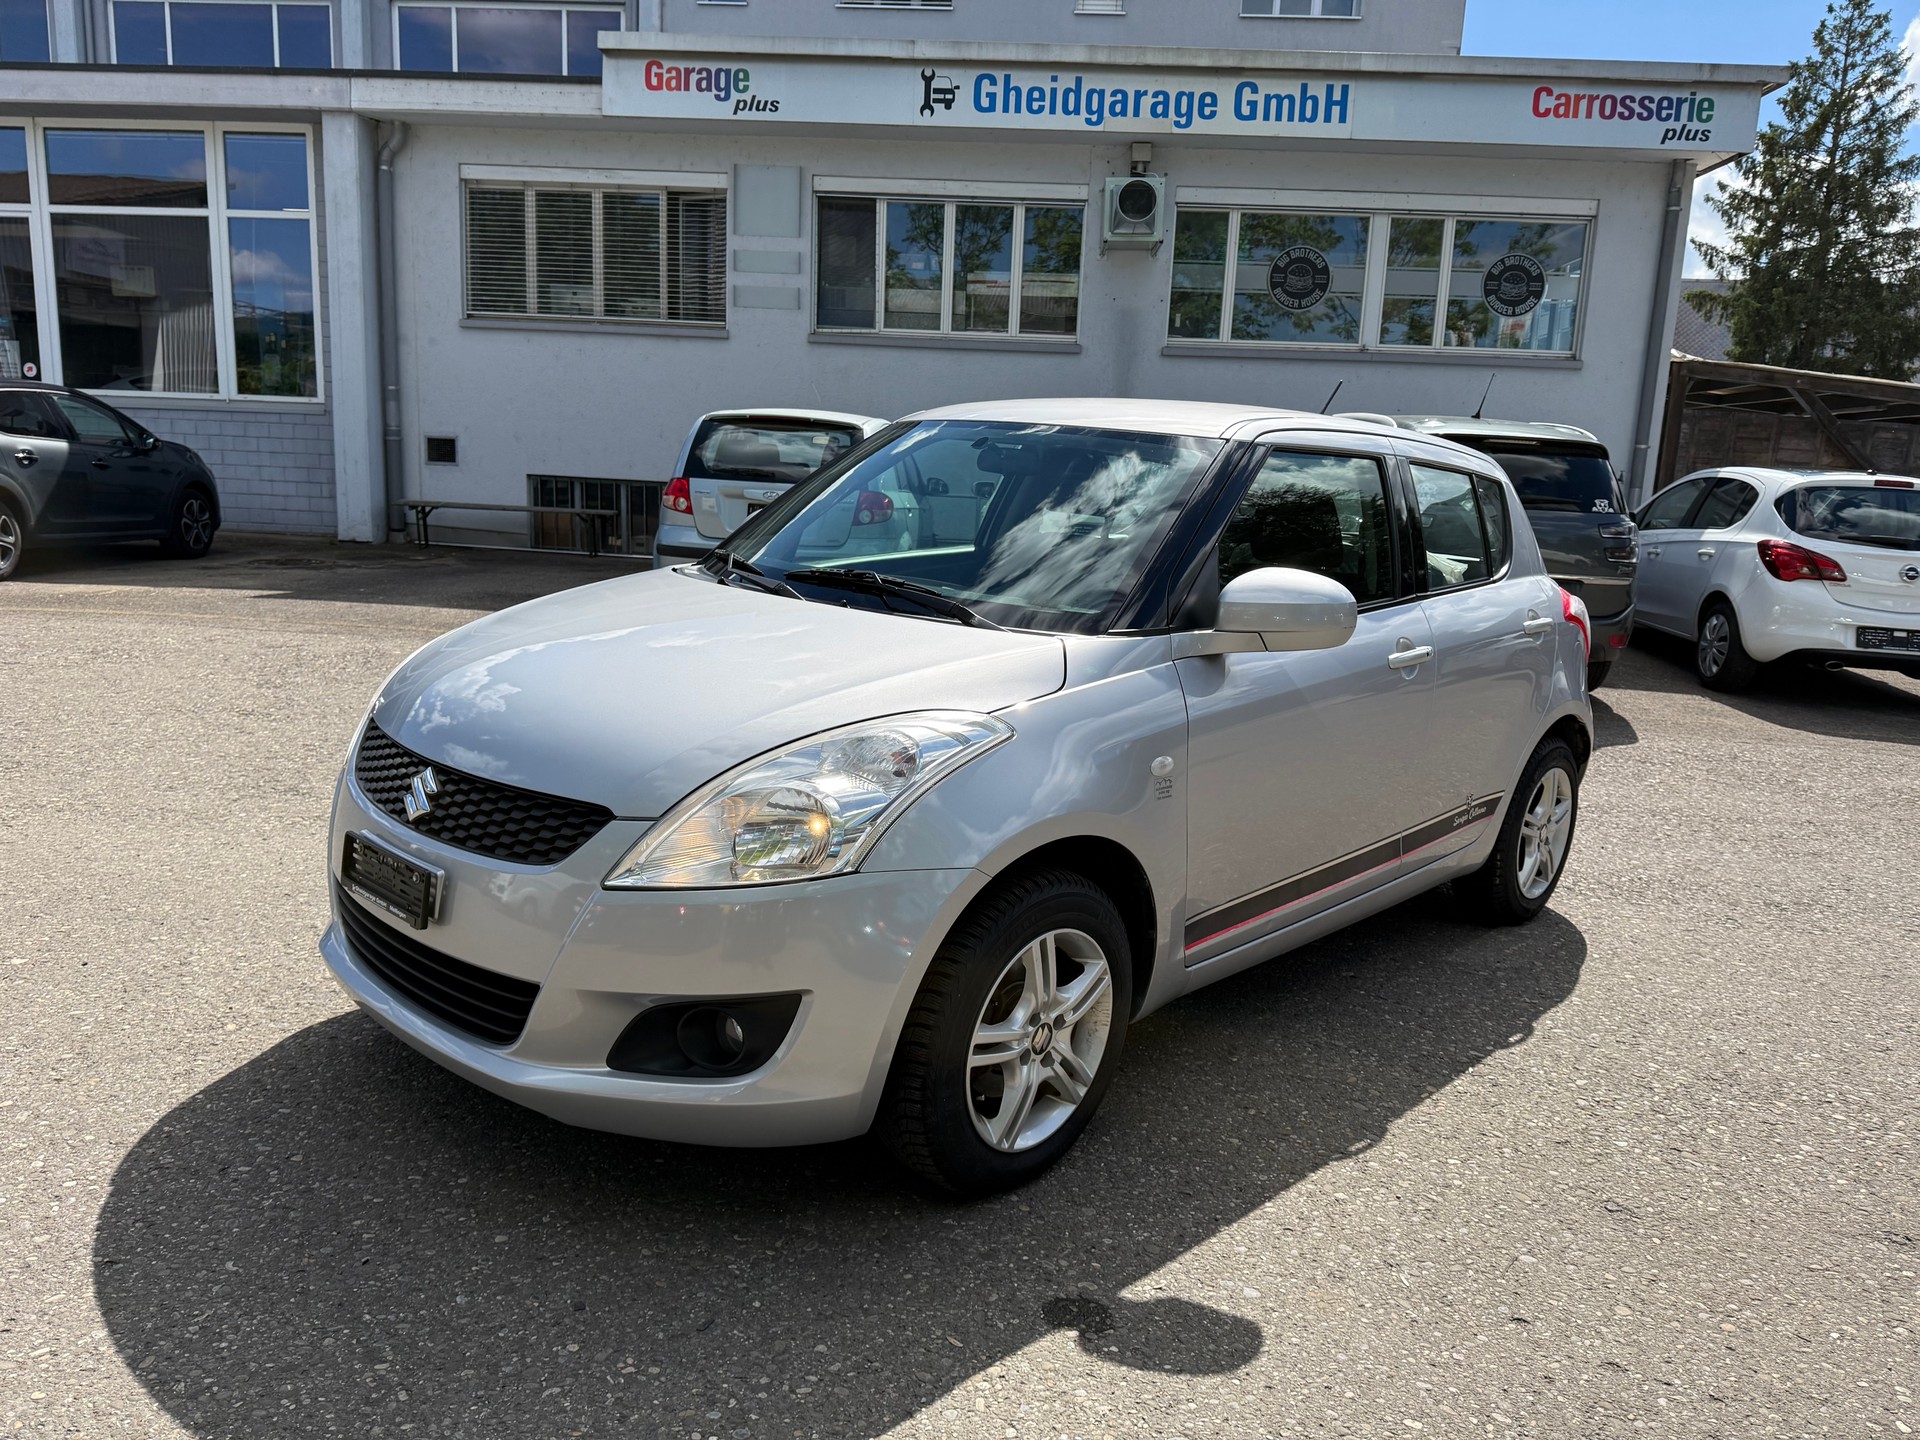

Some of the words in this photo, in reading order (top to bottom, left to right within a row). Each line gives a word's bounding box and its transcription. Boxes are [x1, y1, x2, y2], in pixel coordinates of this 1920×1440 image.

[644, 59, 750, 102] Garage
[732, 94, 781, 116] plus
[973, 72, 1219, 129] Gheidgarage
[1233, 80, 1351, 125] GmbH
[1531, 85, 1715, 124] Carrosserie
[1659, 123, 1712, 145] plus
[1276, 254, 1290, 268] BIG
[1289, 248, 1326, 269] BROTHERS
[1490, 261, 1505, 276] BIG
[1503, 256, 1541, 277] BROTHERS
[1273, 287, 1300, 308] BURGER
[1300, 288, 1324, 308] HOUSE
[1486, 294, 1514, 316] BURGER
[1514, 295, 1539, 315] HOUSE
